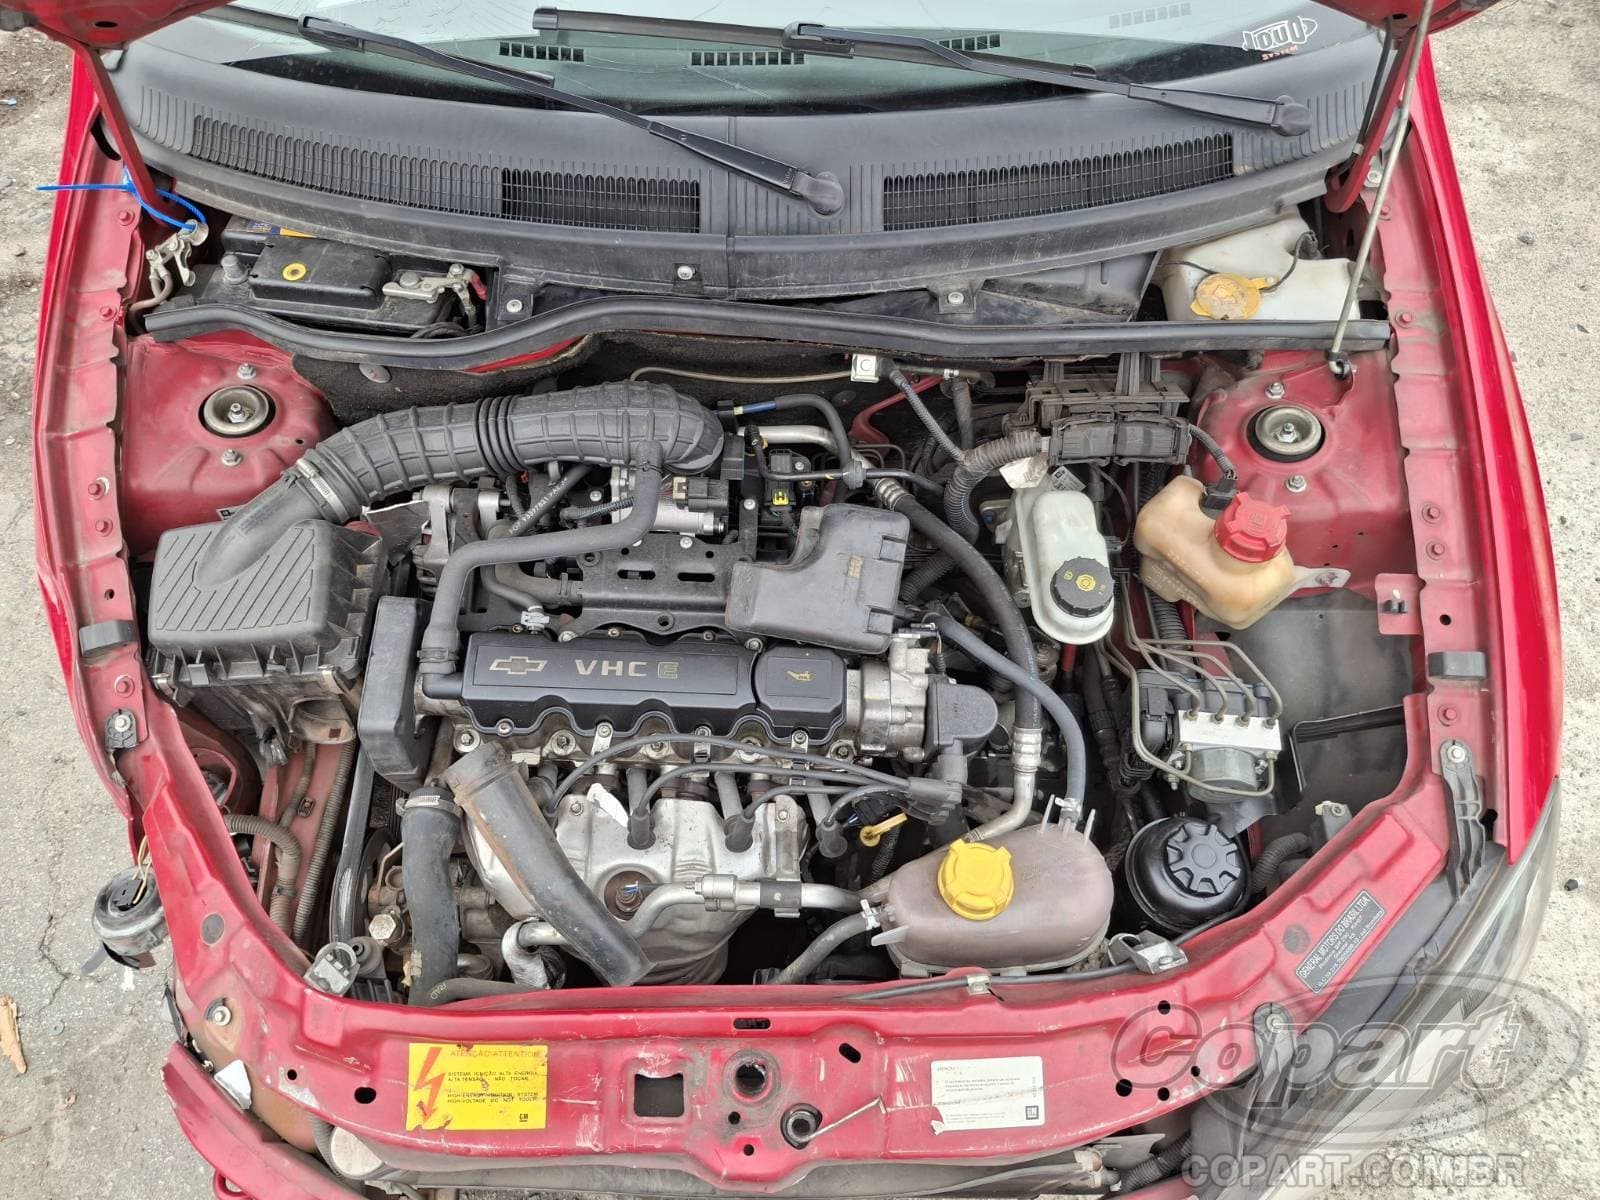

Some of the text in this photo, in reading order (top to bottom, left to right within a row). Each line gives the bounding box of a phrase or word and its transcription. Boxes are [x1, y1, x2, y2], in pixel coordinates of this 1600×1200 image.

[574, 659, 679, 679] VHC E
[1299, 895, 1370, 979] GENERAL MOTORS DO BRASIL LTDA
